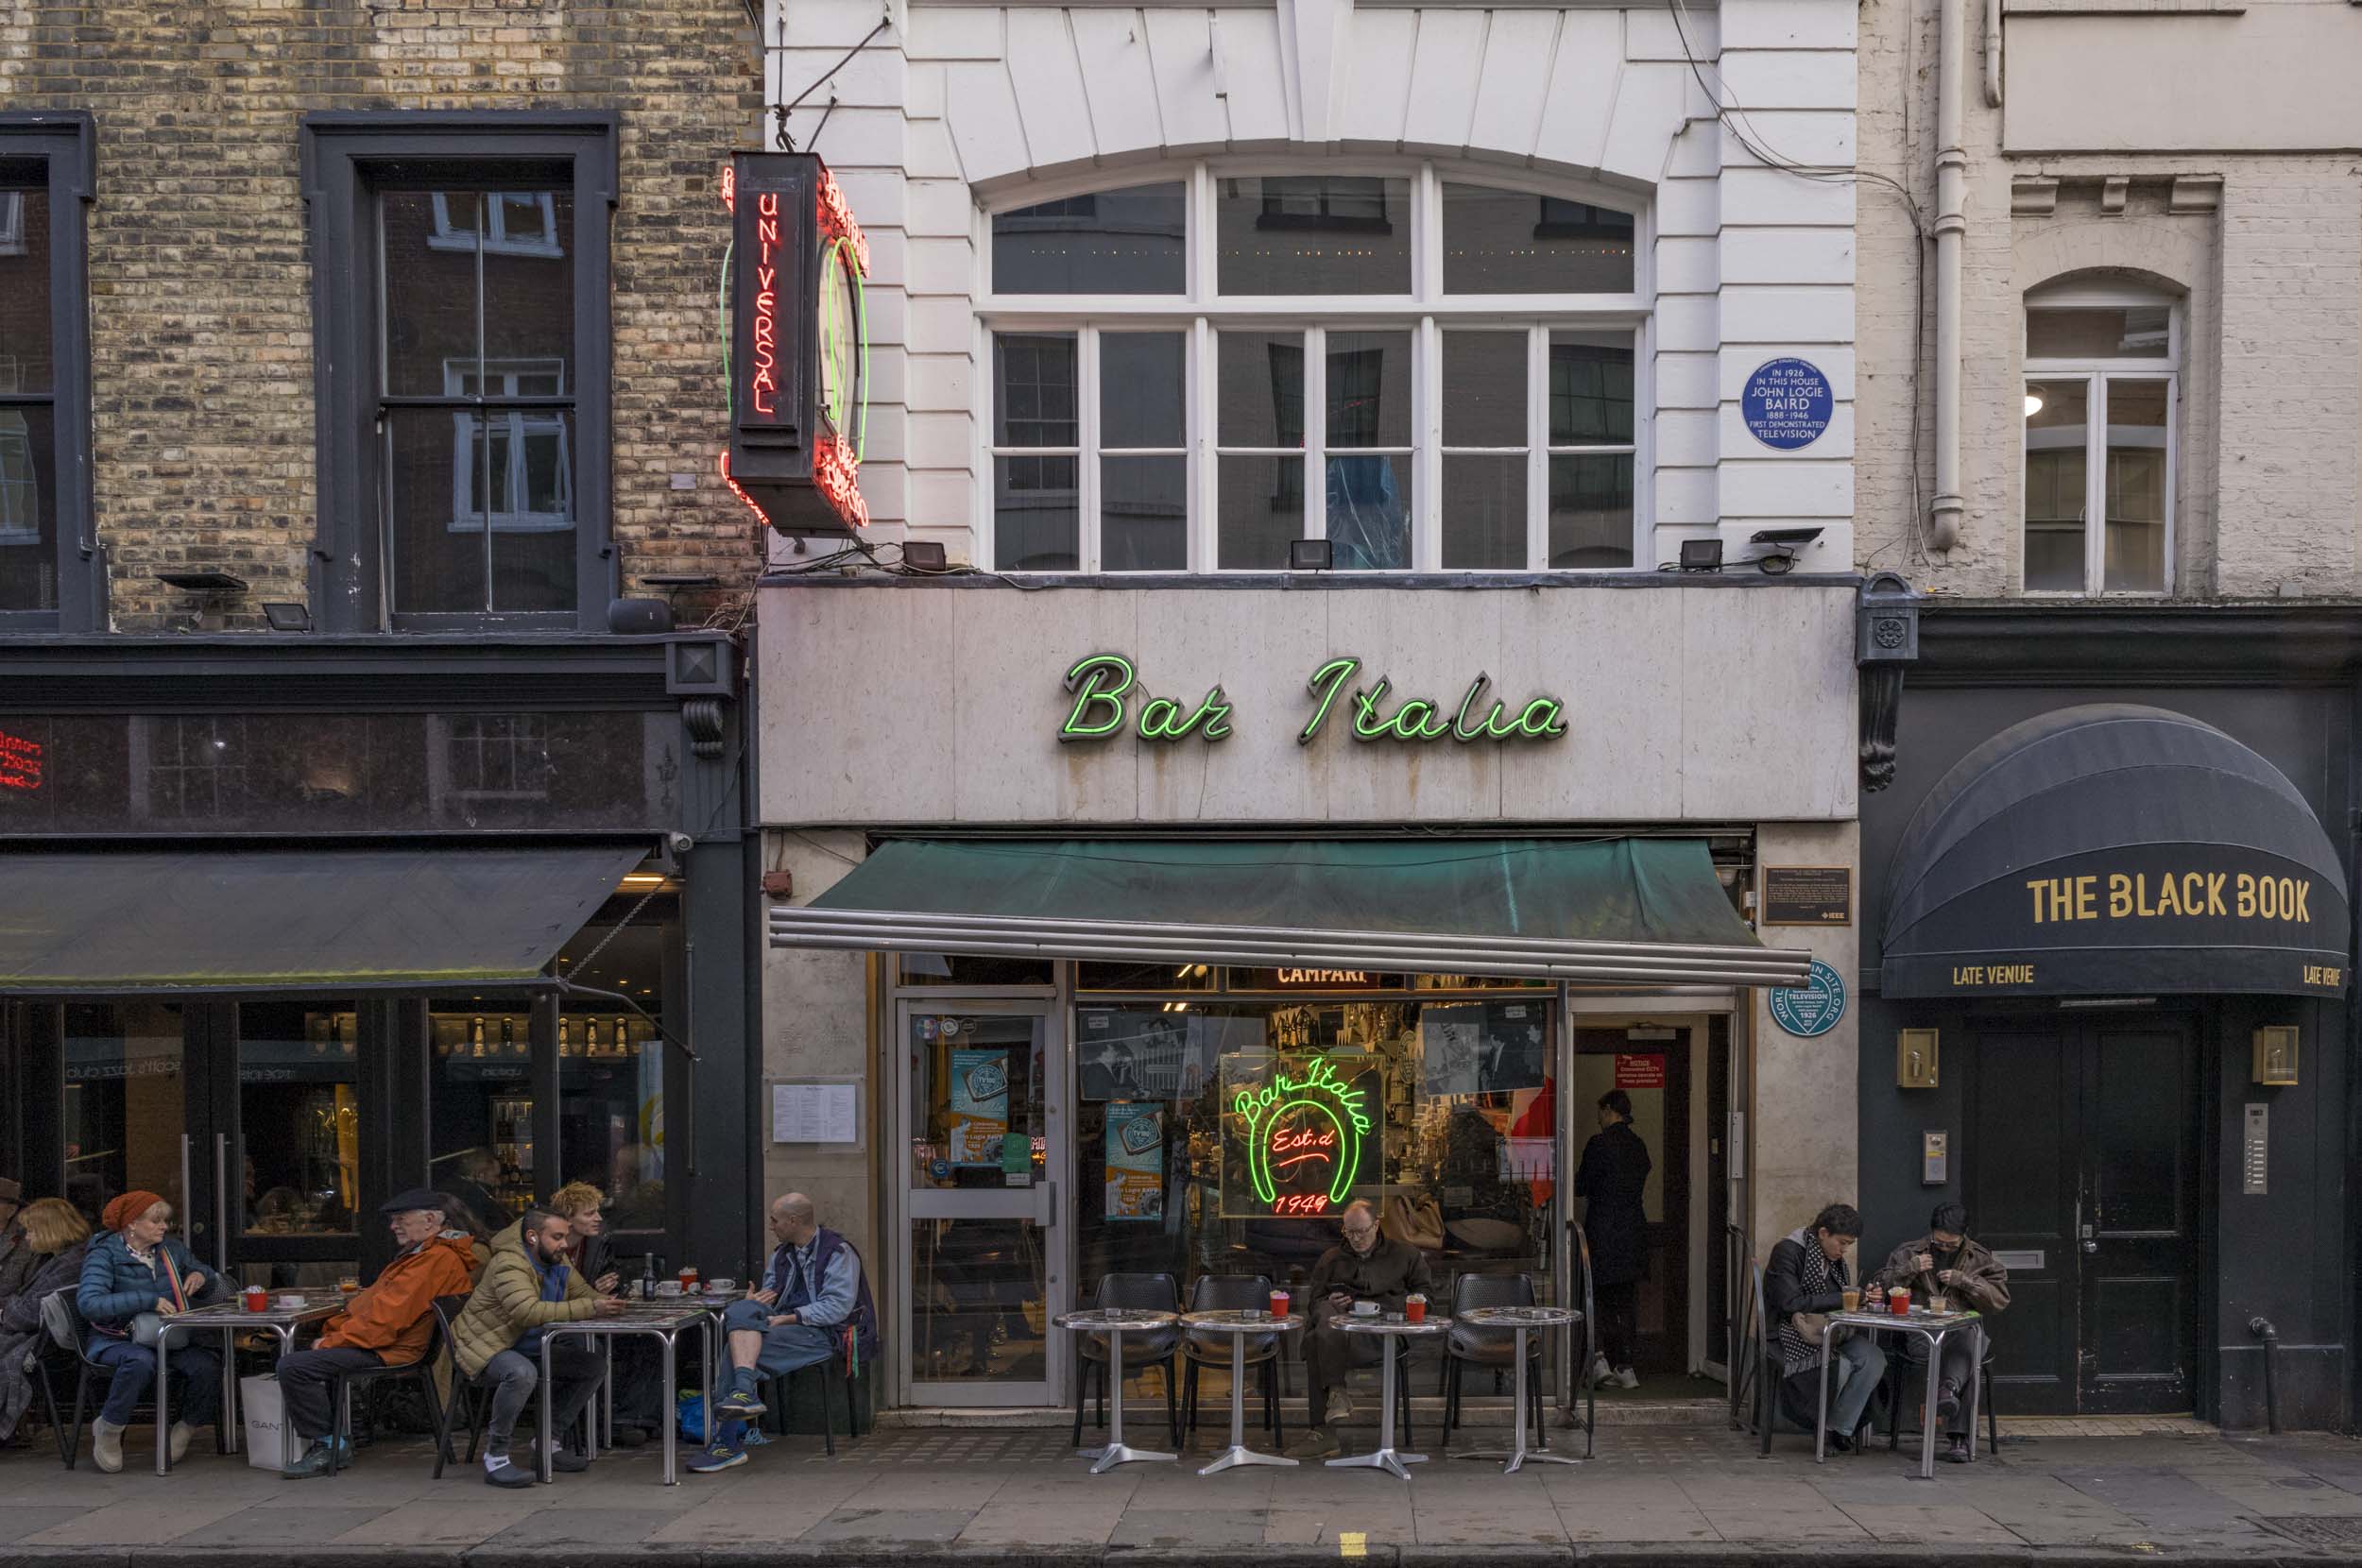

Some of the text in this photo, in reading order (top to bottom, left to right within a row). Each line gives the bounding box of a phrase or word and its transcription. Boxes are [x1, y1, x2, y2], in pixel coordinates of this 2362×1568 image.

[753, 194, 778, 414] UNIVERSAL
[1752, 387, 1823, 398] JOHN LOGIE
[1765, 398, 1810, 410] BAIRD
[1758, 430, 1816, 438] TELEVISION
[1057, 652, 1570, 744] Bar Italia
[2027, 871, 2310, 923] THE BLACK BOOK
[1953, 964, 2034, 984] LATE VENUE
[2303, 965, 2340, 986] LATE VENUE
[1776, 990, 1789, 1021] WORL
[1235, 1073, 1295, 1127] Bar
[1308, 1057, 1371, 1134] Italia
[1275, 1194, 1328, 1214] 1949
